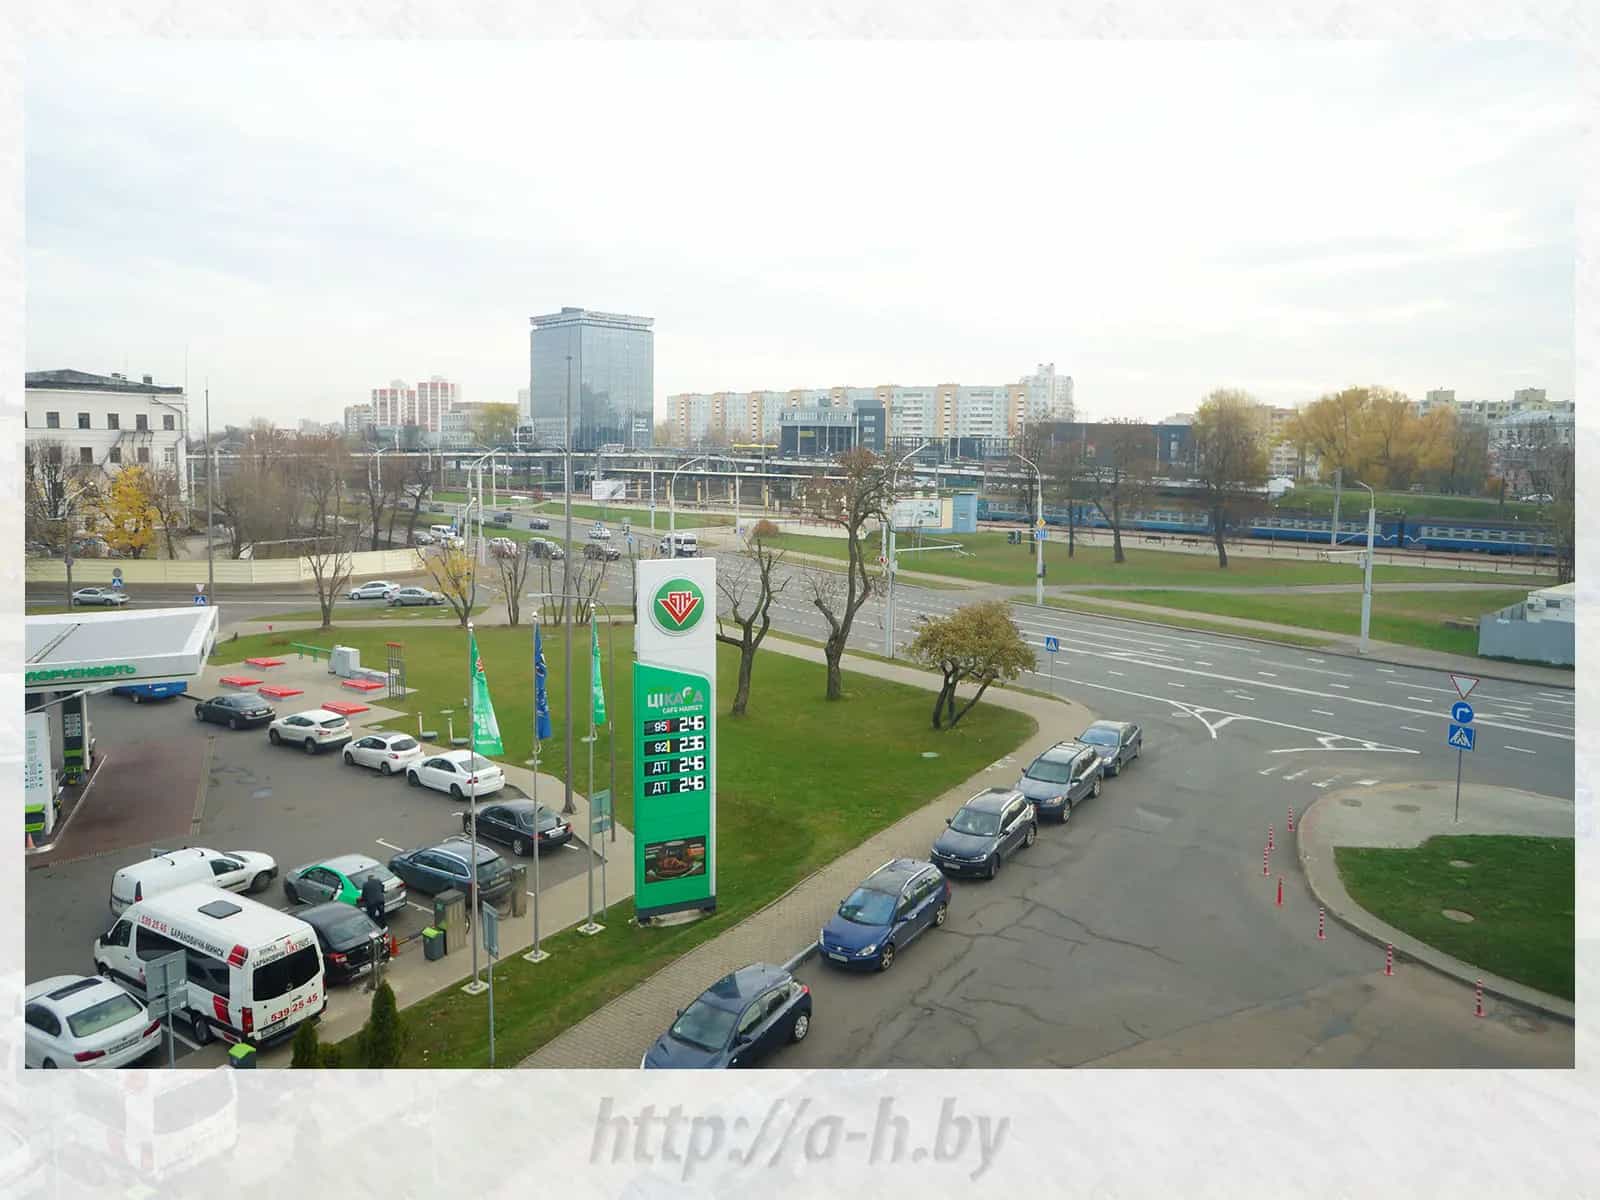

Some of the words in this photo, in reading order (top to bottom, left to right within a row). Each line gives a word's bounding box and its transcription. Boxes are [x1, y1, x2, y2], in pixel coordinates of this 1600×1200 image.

[654, 721, 667, 732] 95
[654, 742, 667, 752] 92
[652, 761, 667, 774] ДТ
[652, 781, 667, 794] ДТ
[271, 1007, 290, 1022] 539
[291, 1000, 305, 1013] 25
[306, 993, 318, 1004] 45
